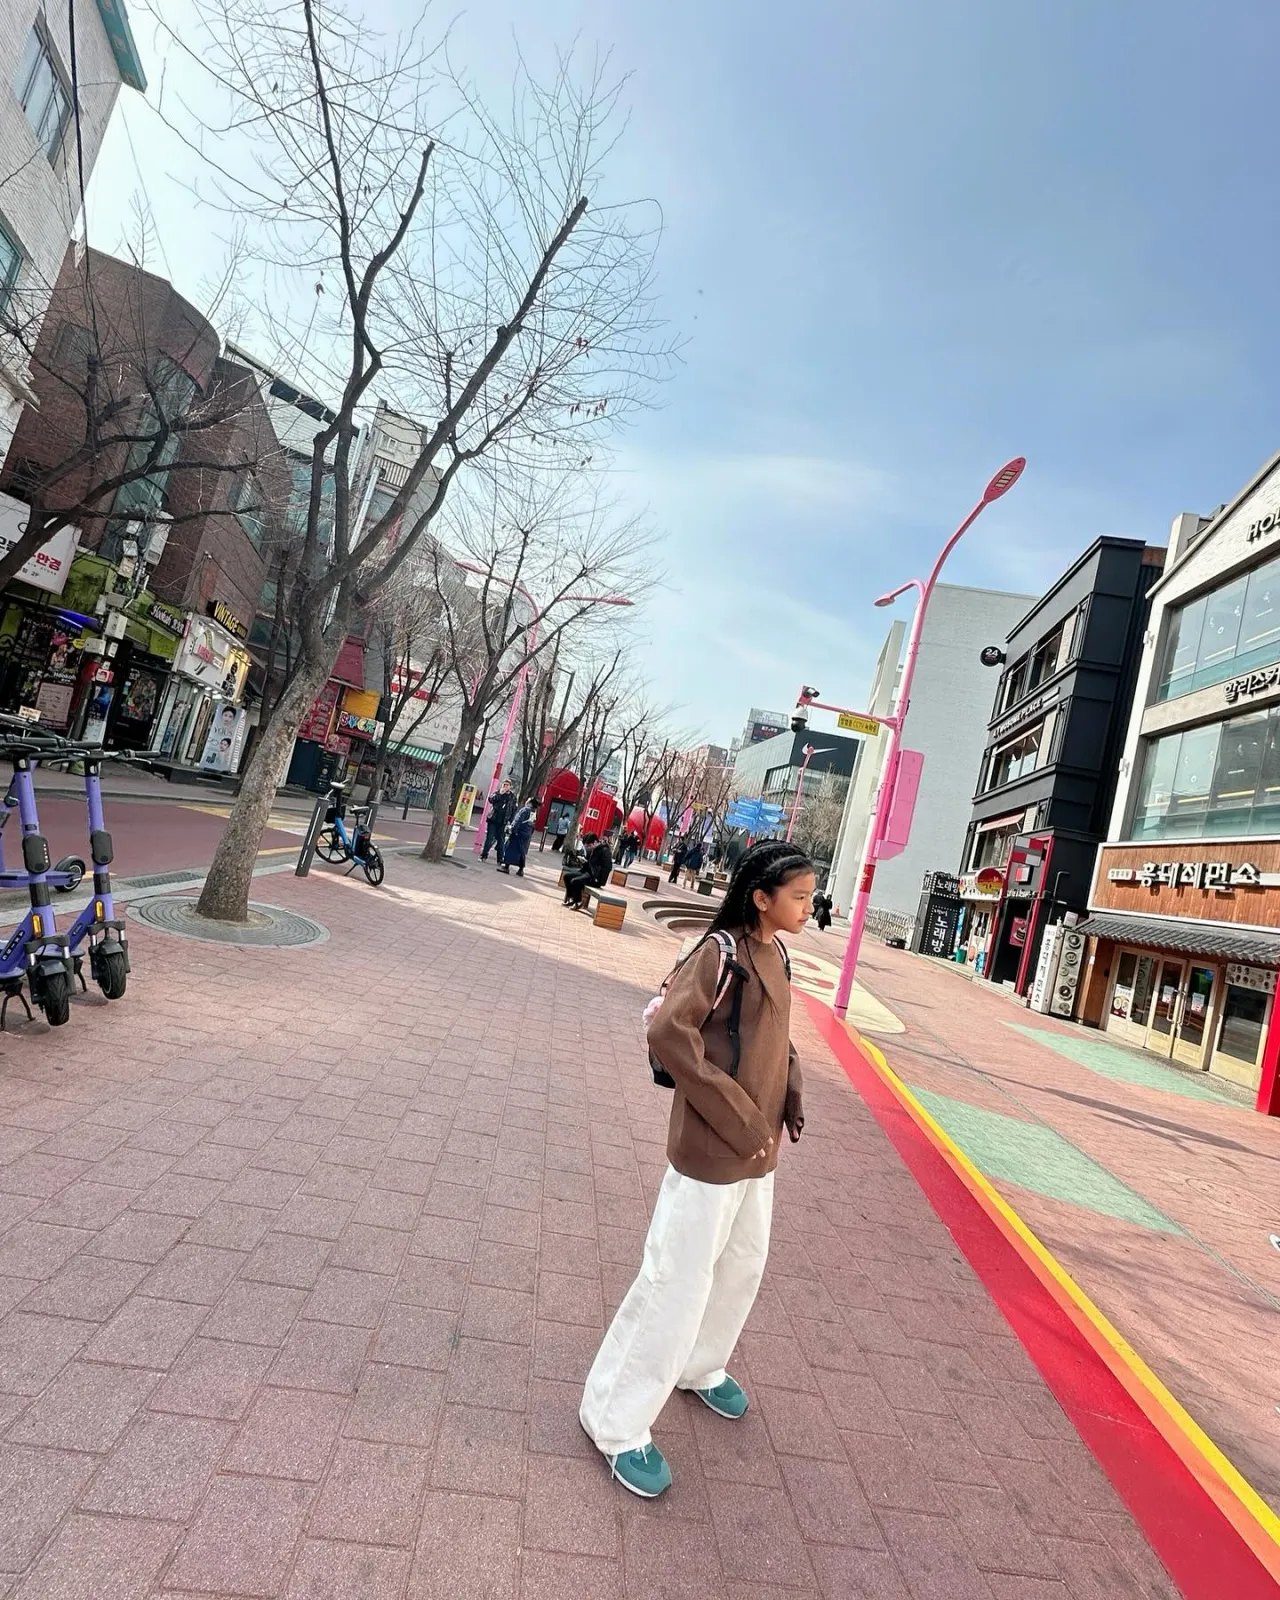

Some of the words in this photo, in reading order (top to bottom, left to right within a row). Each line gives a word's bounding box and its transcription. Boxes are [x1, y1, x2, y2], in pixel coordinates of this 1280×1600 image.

[213, 601, 239, 633] VINTAGE
[985, 648, 999, 656] 24
[936, 879, 959, 894] 노래방
[931, 915, 949, 953] 노래방
